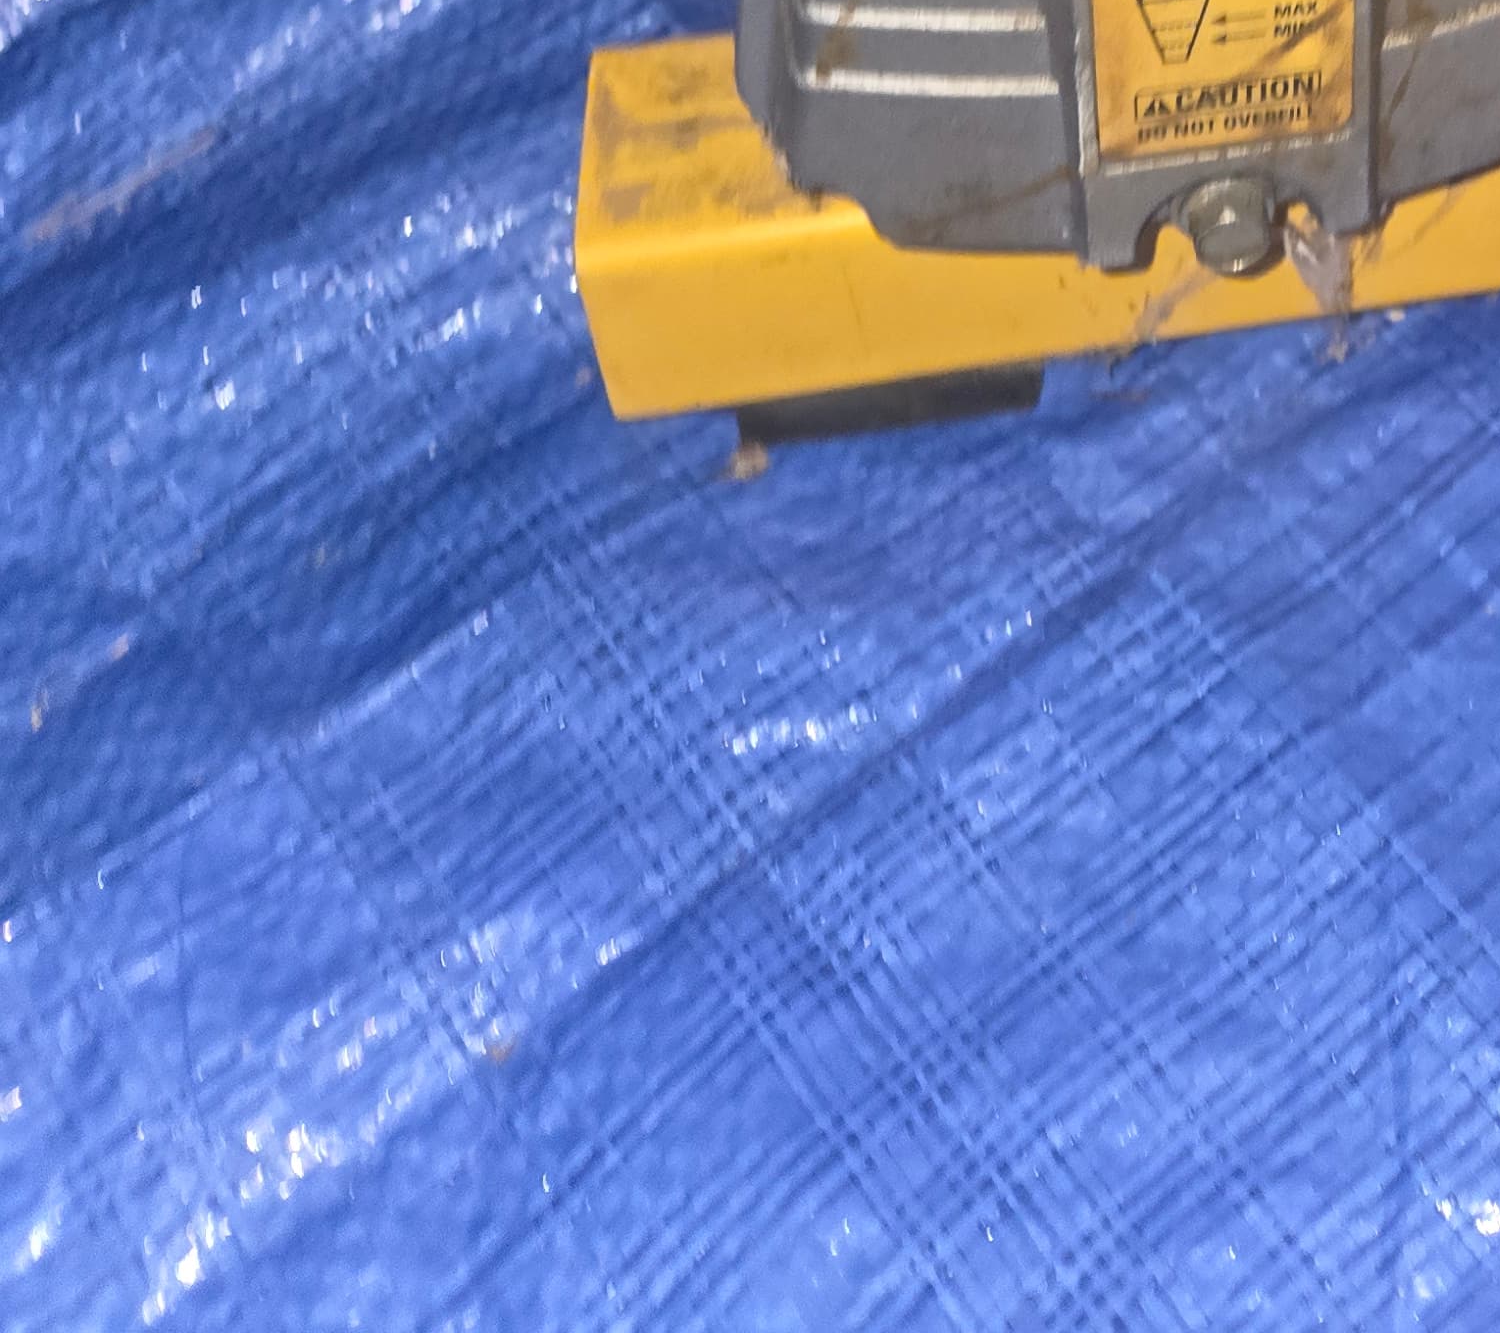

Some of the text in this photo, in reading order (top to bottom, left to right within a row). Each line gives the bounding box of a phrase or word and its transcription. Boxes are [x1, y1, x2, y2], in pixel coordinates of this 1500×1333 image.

[1273, 0, 1318, 19] MAX
[1175, 71, 1314, 114] CAUTION
[1138, 101, 1313, 145] DO NOT OVERFILL
